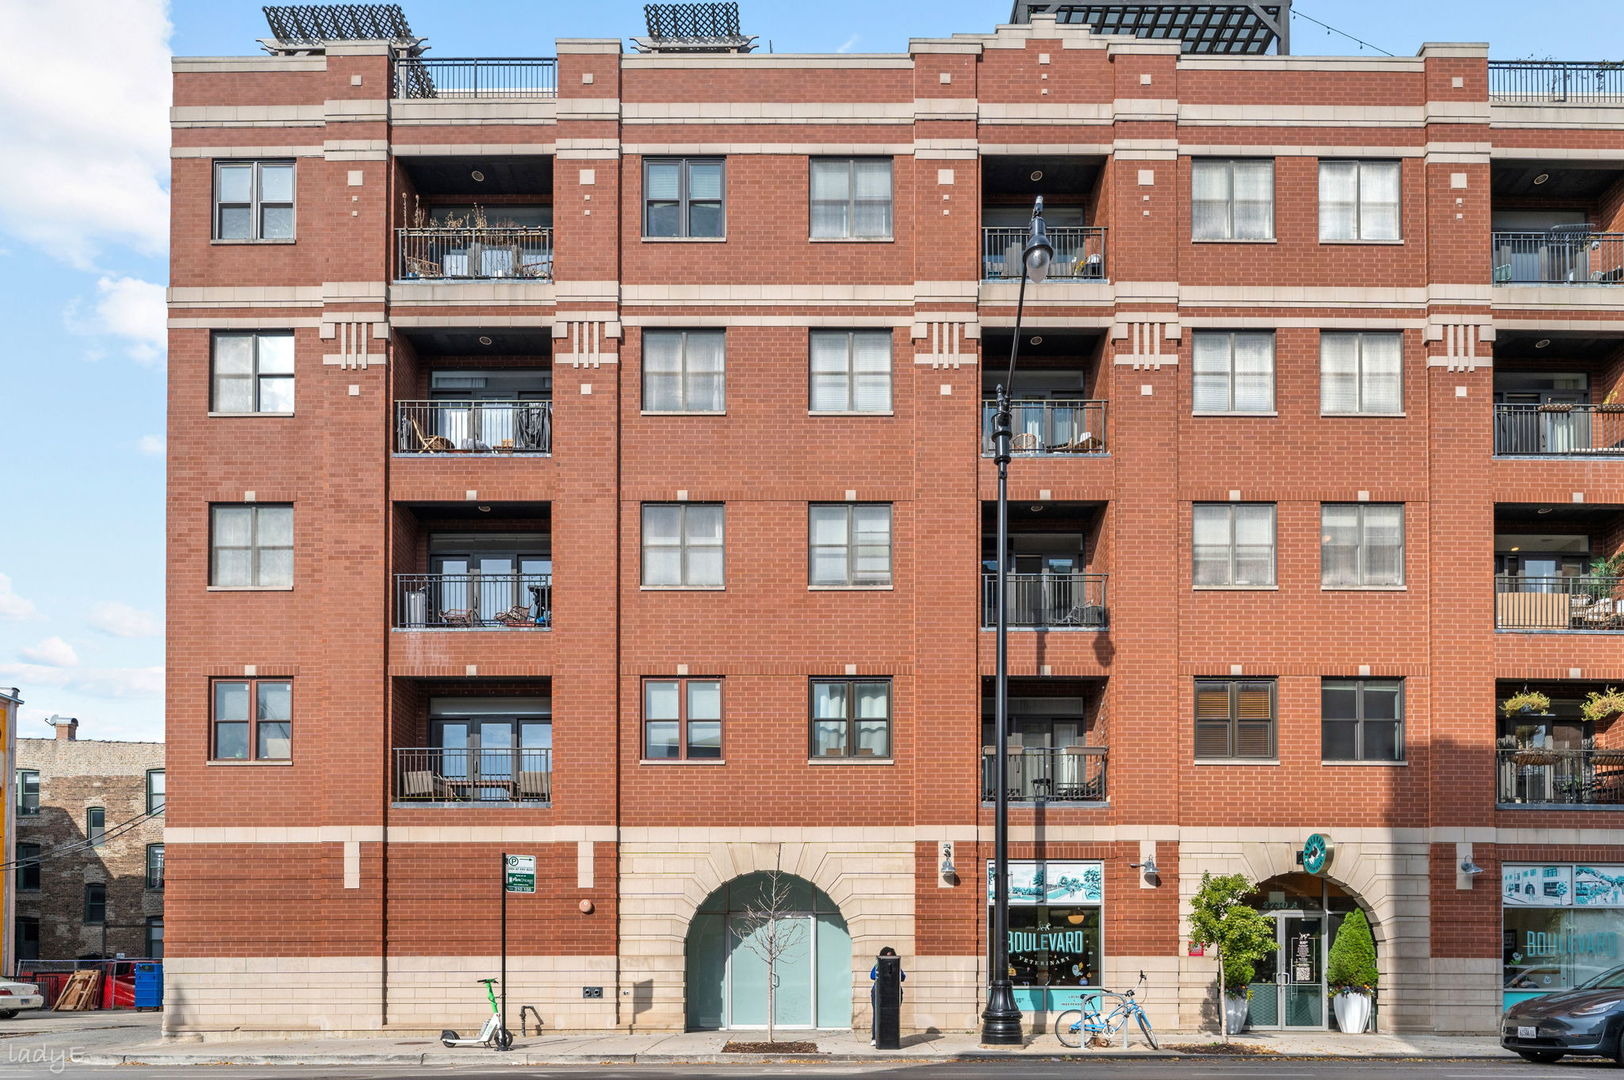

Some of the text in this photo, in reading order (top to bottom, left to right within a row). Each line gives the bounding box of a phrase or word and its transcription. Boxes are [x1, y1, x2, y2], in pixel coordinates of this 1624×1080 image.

[1008, 930, 1083, 954] BOULEVARD
[1526, 930, 1617, 957] BOULEVARD
[1019, 955, 1070, 966] VETERINARY
